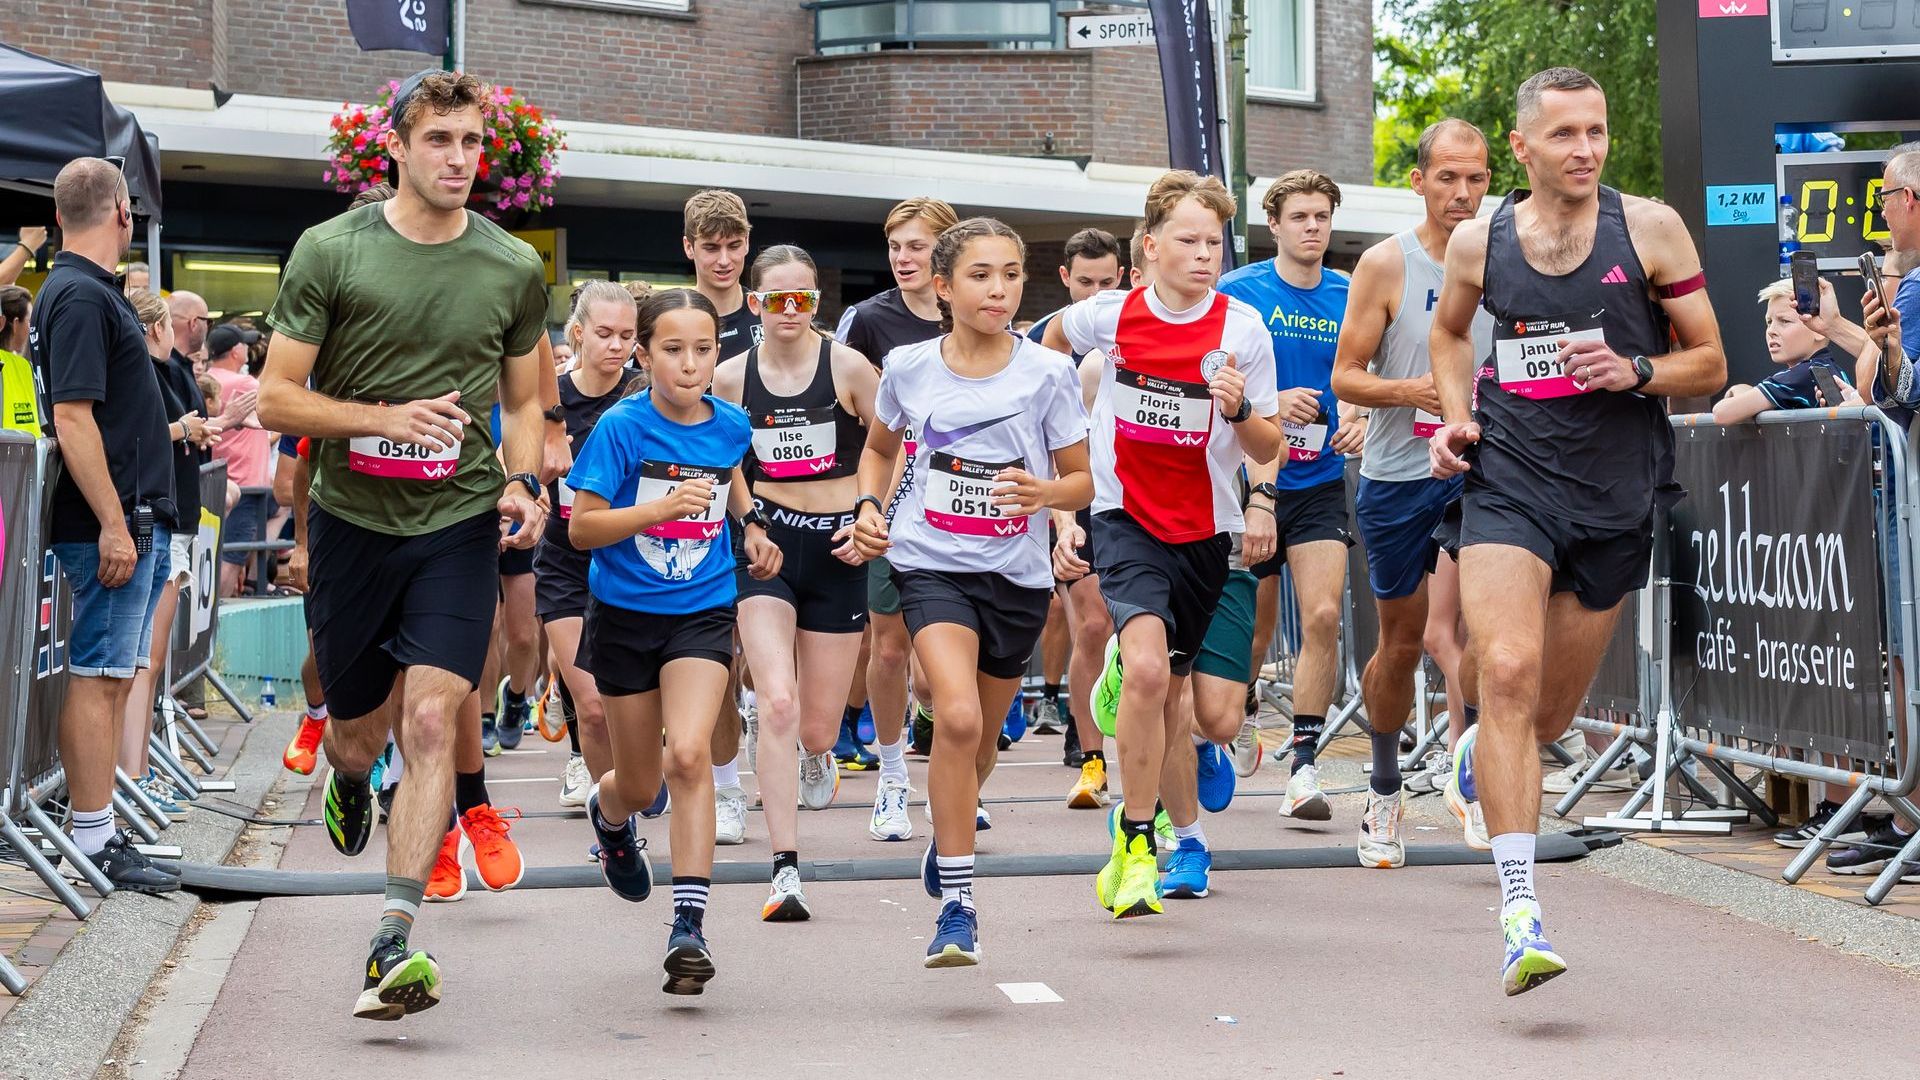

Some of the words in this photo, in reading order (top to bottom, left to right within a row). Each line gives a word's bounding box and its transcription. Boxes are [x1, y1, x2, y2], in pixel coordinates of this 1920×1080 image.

[1717, 193, 1738, 208] 1,2
[1742, 192, 1765, 205] KM
[1268, 305, 1338, 334] Ariesen
[1527, 324, 1549, 332] VALLEY
[1550, 321, 1565, 329] RUN
[1520, 342, 1562, 360] Janu
[1526, 360, 1562, 379] 091
[1147, 381, 1168, 390] VALLEY
[1139, 395, 1181, 412] Floris
[1135, 409, 1181, 430] 0864
[779, 431, 803, 442] Ilse
[378, 440, 431, 459] 0540
[772, 444, 814, 461] 0806
[680, 470, 702, 478] VALLEY
[962, 465, 984, 474] VALLEY
[951, 498, 1001, 518] 0515
[771, 508, 835, 530] NIKE
[1691, 480, 1854, 613] zeldzaam
[1696, 617, 1737, 674] café
[1756, 621, 1856, 690] brasserie
[1501, 860, 1527, 869] YOU
[1509, 877, 1526, 885] DO
